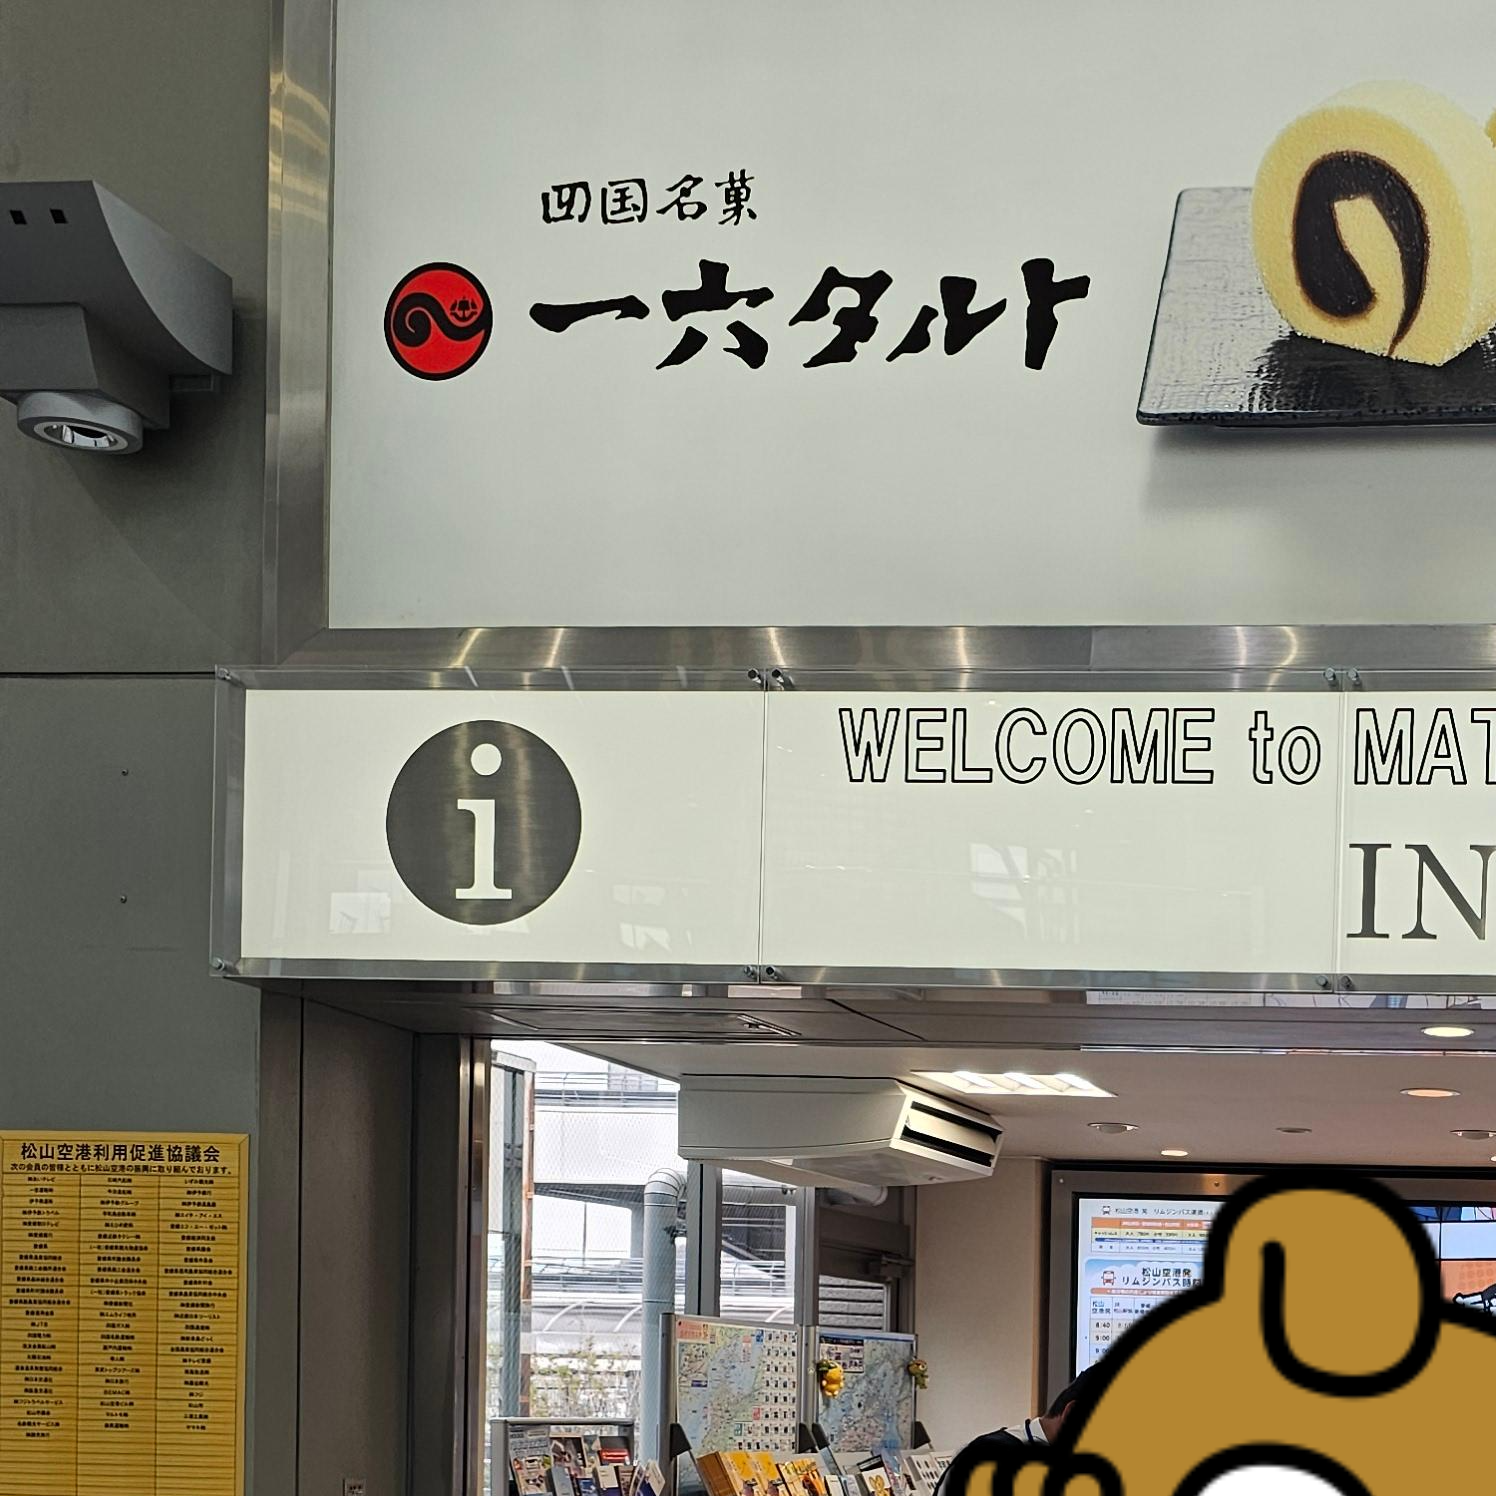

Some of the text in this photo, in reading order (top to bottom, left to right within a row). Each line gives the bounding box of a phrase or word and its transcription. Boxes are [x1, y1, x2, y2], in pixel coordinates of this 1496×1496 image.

[541, 168, 760, 226] 四国名菓
[529, 257, 1091, 371] 一六タルト
[838, 707, 1215, 784] WELCOME
[1248, 710, 1321, 784] to
[21, 1142, 221, 1163] 松山空港利用促進協議会
[1141, 1267, 1193, 1278] 松山空港発
